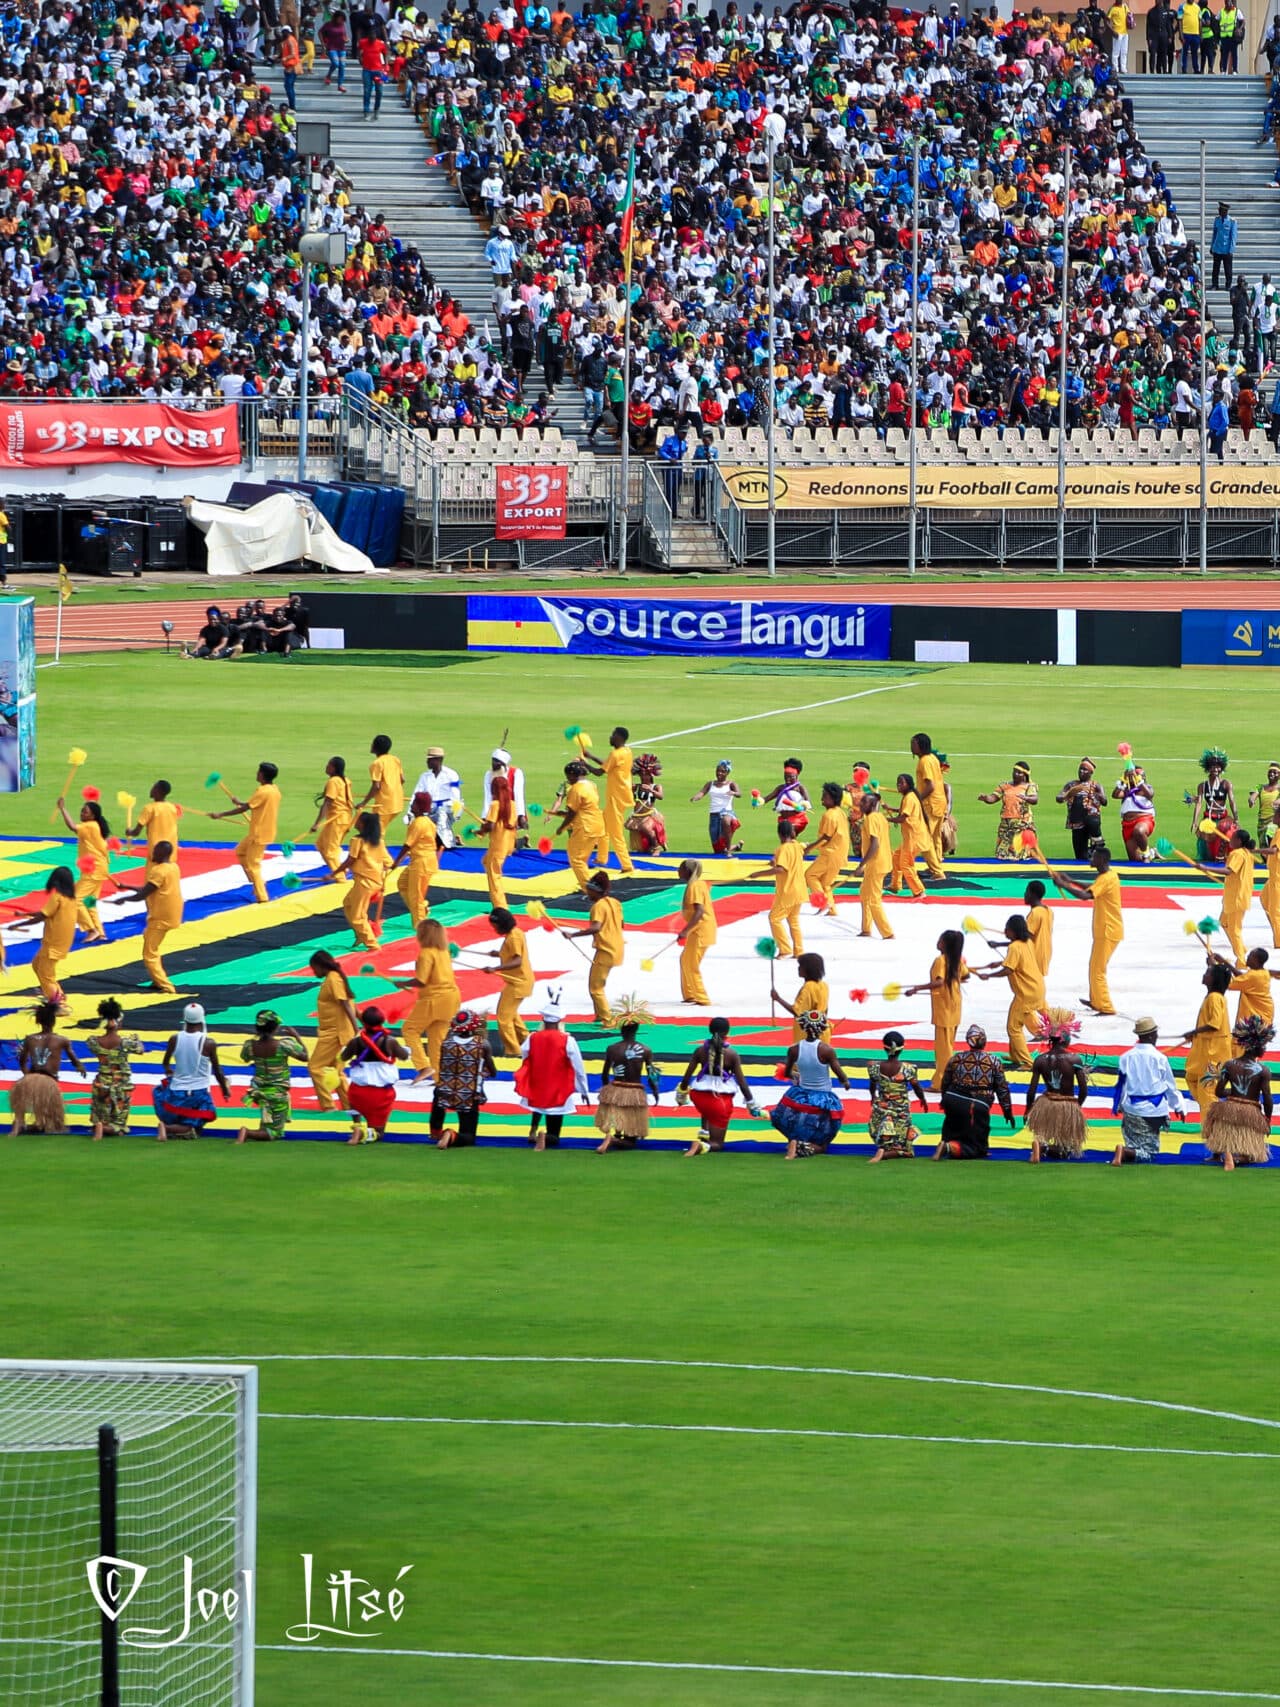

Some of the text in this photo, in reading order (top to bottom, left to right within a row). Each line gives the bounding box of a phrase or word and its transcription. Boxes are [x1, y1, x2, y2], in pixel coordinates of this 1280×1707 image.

[102, 426, 226, 448] EXPORT
[808, 481, 908, 496] Redonnons
[914, 484, 935, 495] au
[938, 480, 1011, 496] Football
[1134, 481, 1181, 495] toute
[504, 507, 563, 518] EXPORT
[563, 599, 865, 658] source Tangui
